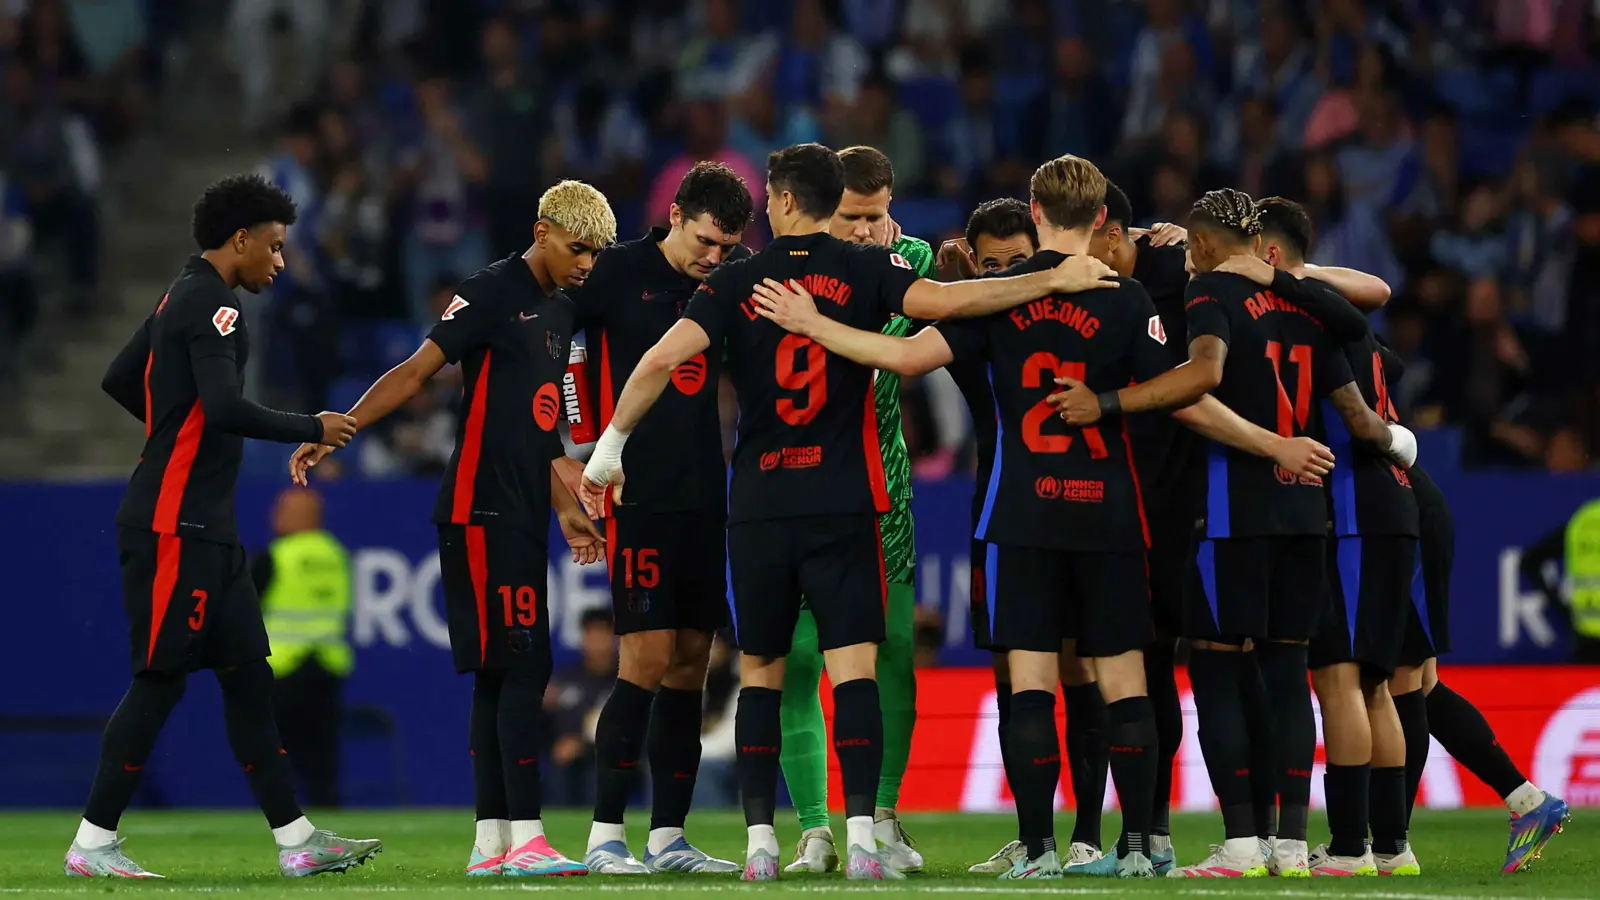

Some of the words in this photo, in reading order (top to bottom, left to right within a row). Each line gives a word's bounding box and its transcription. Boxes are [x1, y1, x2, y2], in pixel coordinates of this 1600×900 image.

[740, 273, 852, 320] LOWSKI
[775, 333, 827, 426] 9
[1264, 340, 1312, 438] 11
[1022, 352, 1108, 459] 21
[1063, 479, 1103, 489] UNHCR
[1063, 488, 1103, 498] ACNUR
[622, 548, 660, 588] 15
[188, 589, 208, 630] 3
[498, 585, 537, 626] 19
